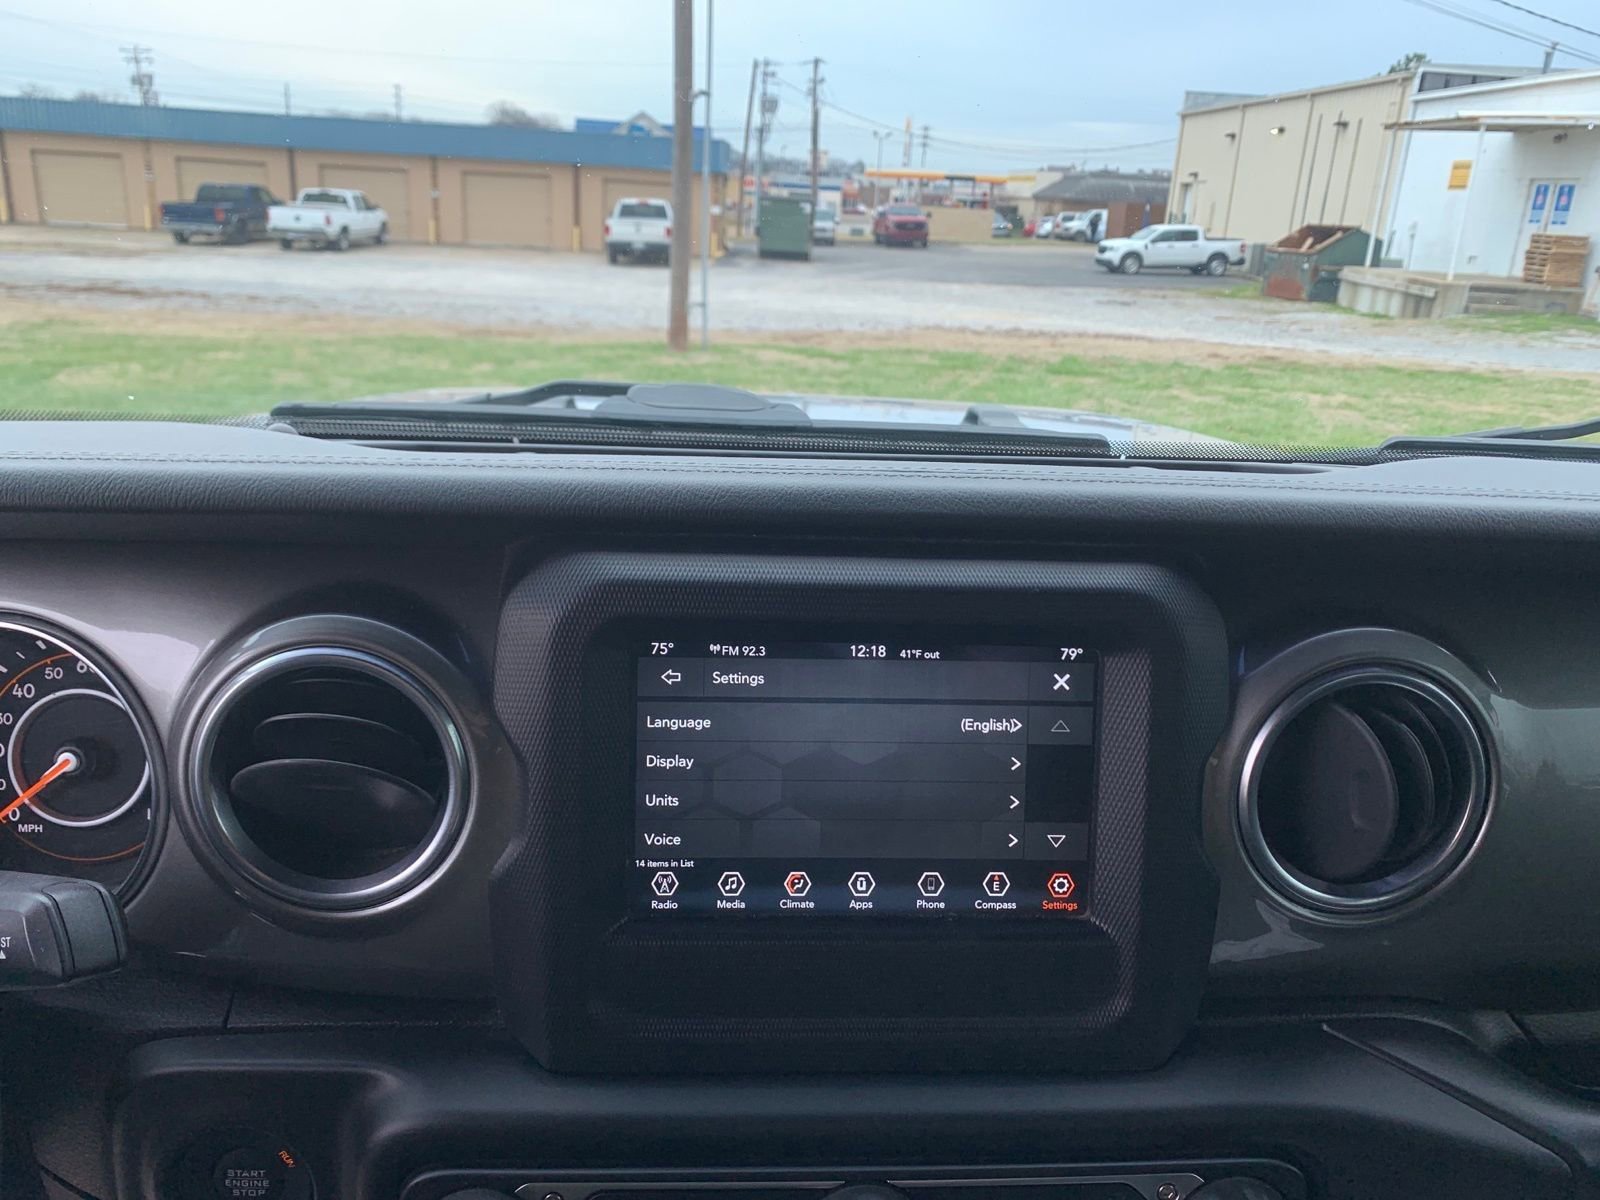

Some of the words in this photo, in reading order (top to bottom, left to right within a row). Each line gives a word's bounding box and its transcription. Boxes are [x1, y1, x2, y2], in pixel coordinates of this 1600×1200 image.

[651, 642, 674, 655] 75°
[721, 646, 739, 656] FM
[742, 646, 766, 656] 92.3
[850, 645, 886, 657] 12:18
[900, 649, 922, 659] 41°F
[924, 651, 940, 659] out
[1060, 647, 1083, 661] 79°
[44, 667, 64, 680] 50
[712, 671, 765, 687] Settings
[12, 683, 35, 698] 40
[647, 716, 712, 731] Language
[960, 718, 1015, 734] (English)
[646, 754, 694, 770] Display
[645, 794, 680, 807] Units
[18, 824, 43, 833] MPH
[644, 833, 682, 846] Voice
[635, 860, 646, 868] 14
[647, 859, 669, 868] items
[670, 859, 679, 868] in
[680, 859, 695, 868] List
[651, 900, 679, 909] Radio
[716, 900, 746, 909] Media
[779, 899, 815, 909] Climate
[849, 900, 873, 910] Apps
[916, 900, 946, 910] Phone
[974, 900, 1017, 911] Compass
[1042, 900, 1078, 911] Settings
[278, 1150, 295, 1168] RUN
[227, 1169, 266, 1177] START
[225, 1179, 270, 1187] ENGINE
[232, 1189, 266, 1197] STOP
